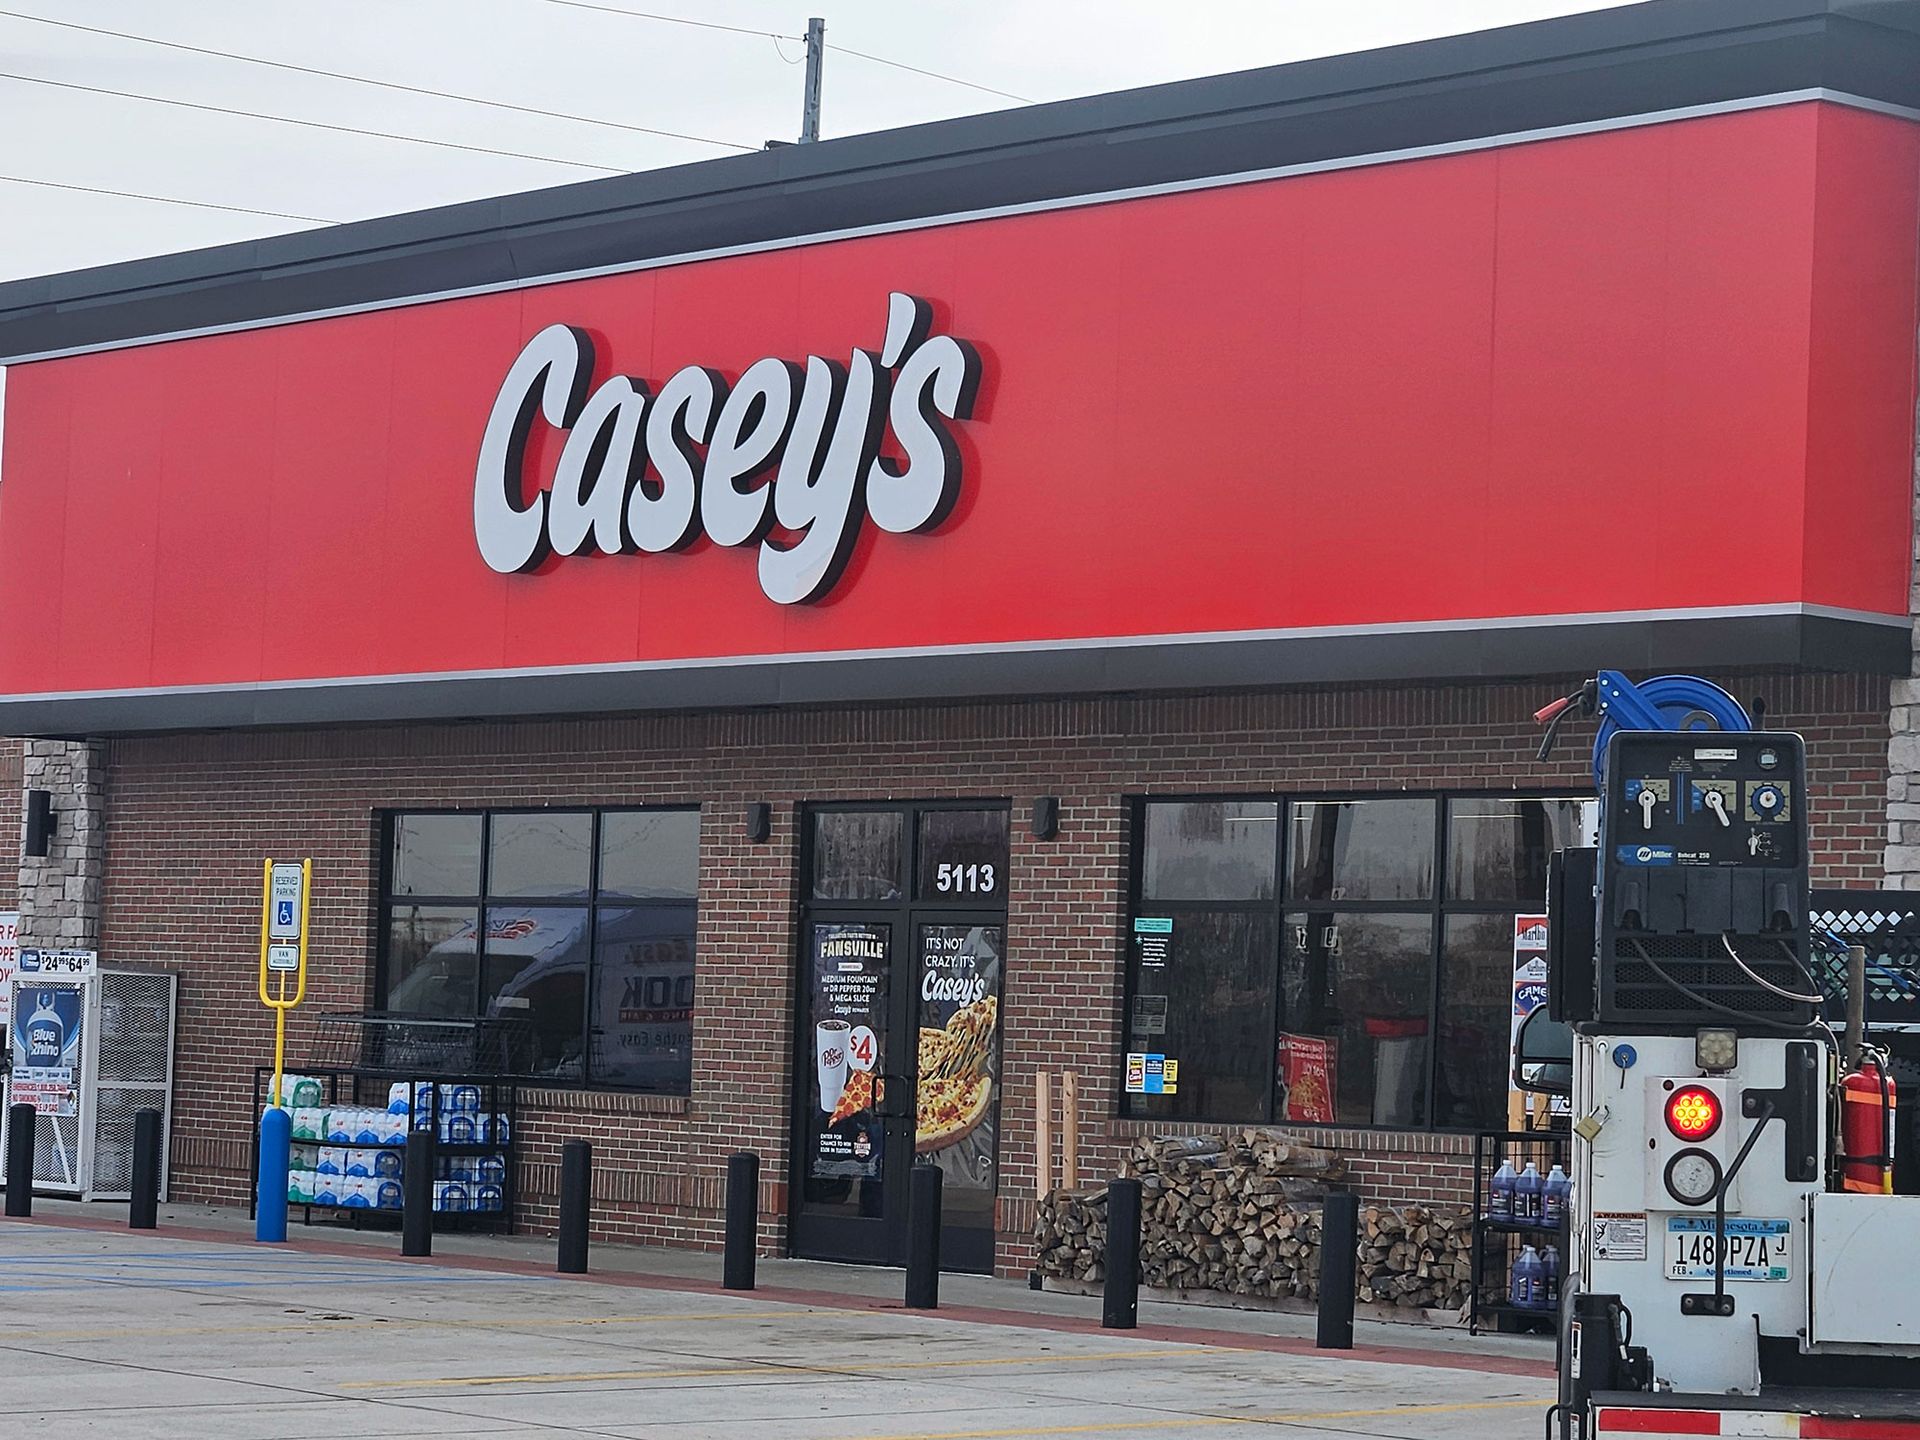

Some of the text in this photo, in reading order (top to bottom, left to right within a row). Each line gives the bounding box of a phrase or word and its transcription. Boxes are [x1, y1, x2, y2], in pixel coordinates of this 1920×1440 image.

[474, 291, 975, 605] Casey's
[936, 863, 995, 893] 5113
[275, 887, 297, 897] PARKING
[820, 940, 884, 959] FANSVILLE
[926, 937, 965, 950] IT'S NOT
[278, 950, 289, 958] VAN
[925, 955, 976, 968] CRAZY. IT'S
[821, 975, 879, 984] MEDIUM FOUNTAIN
[829, 985, 838, 993] DR
[839, 985, 861, 993] PEPPER
[921, 969, 985, 1009] Casey's
[835, 994, 852, 1003] MEGA
[853, 994, 870, 1003] SLICE
[1699, 1219, 1758, 1231] Minesota
[1775, 1236, 1785, 1253] J
[1672, 1266, 1687, 1275] FEB
